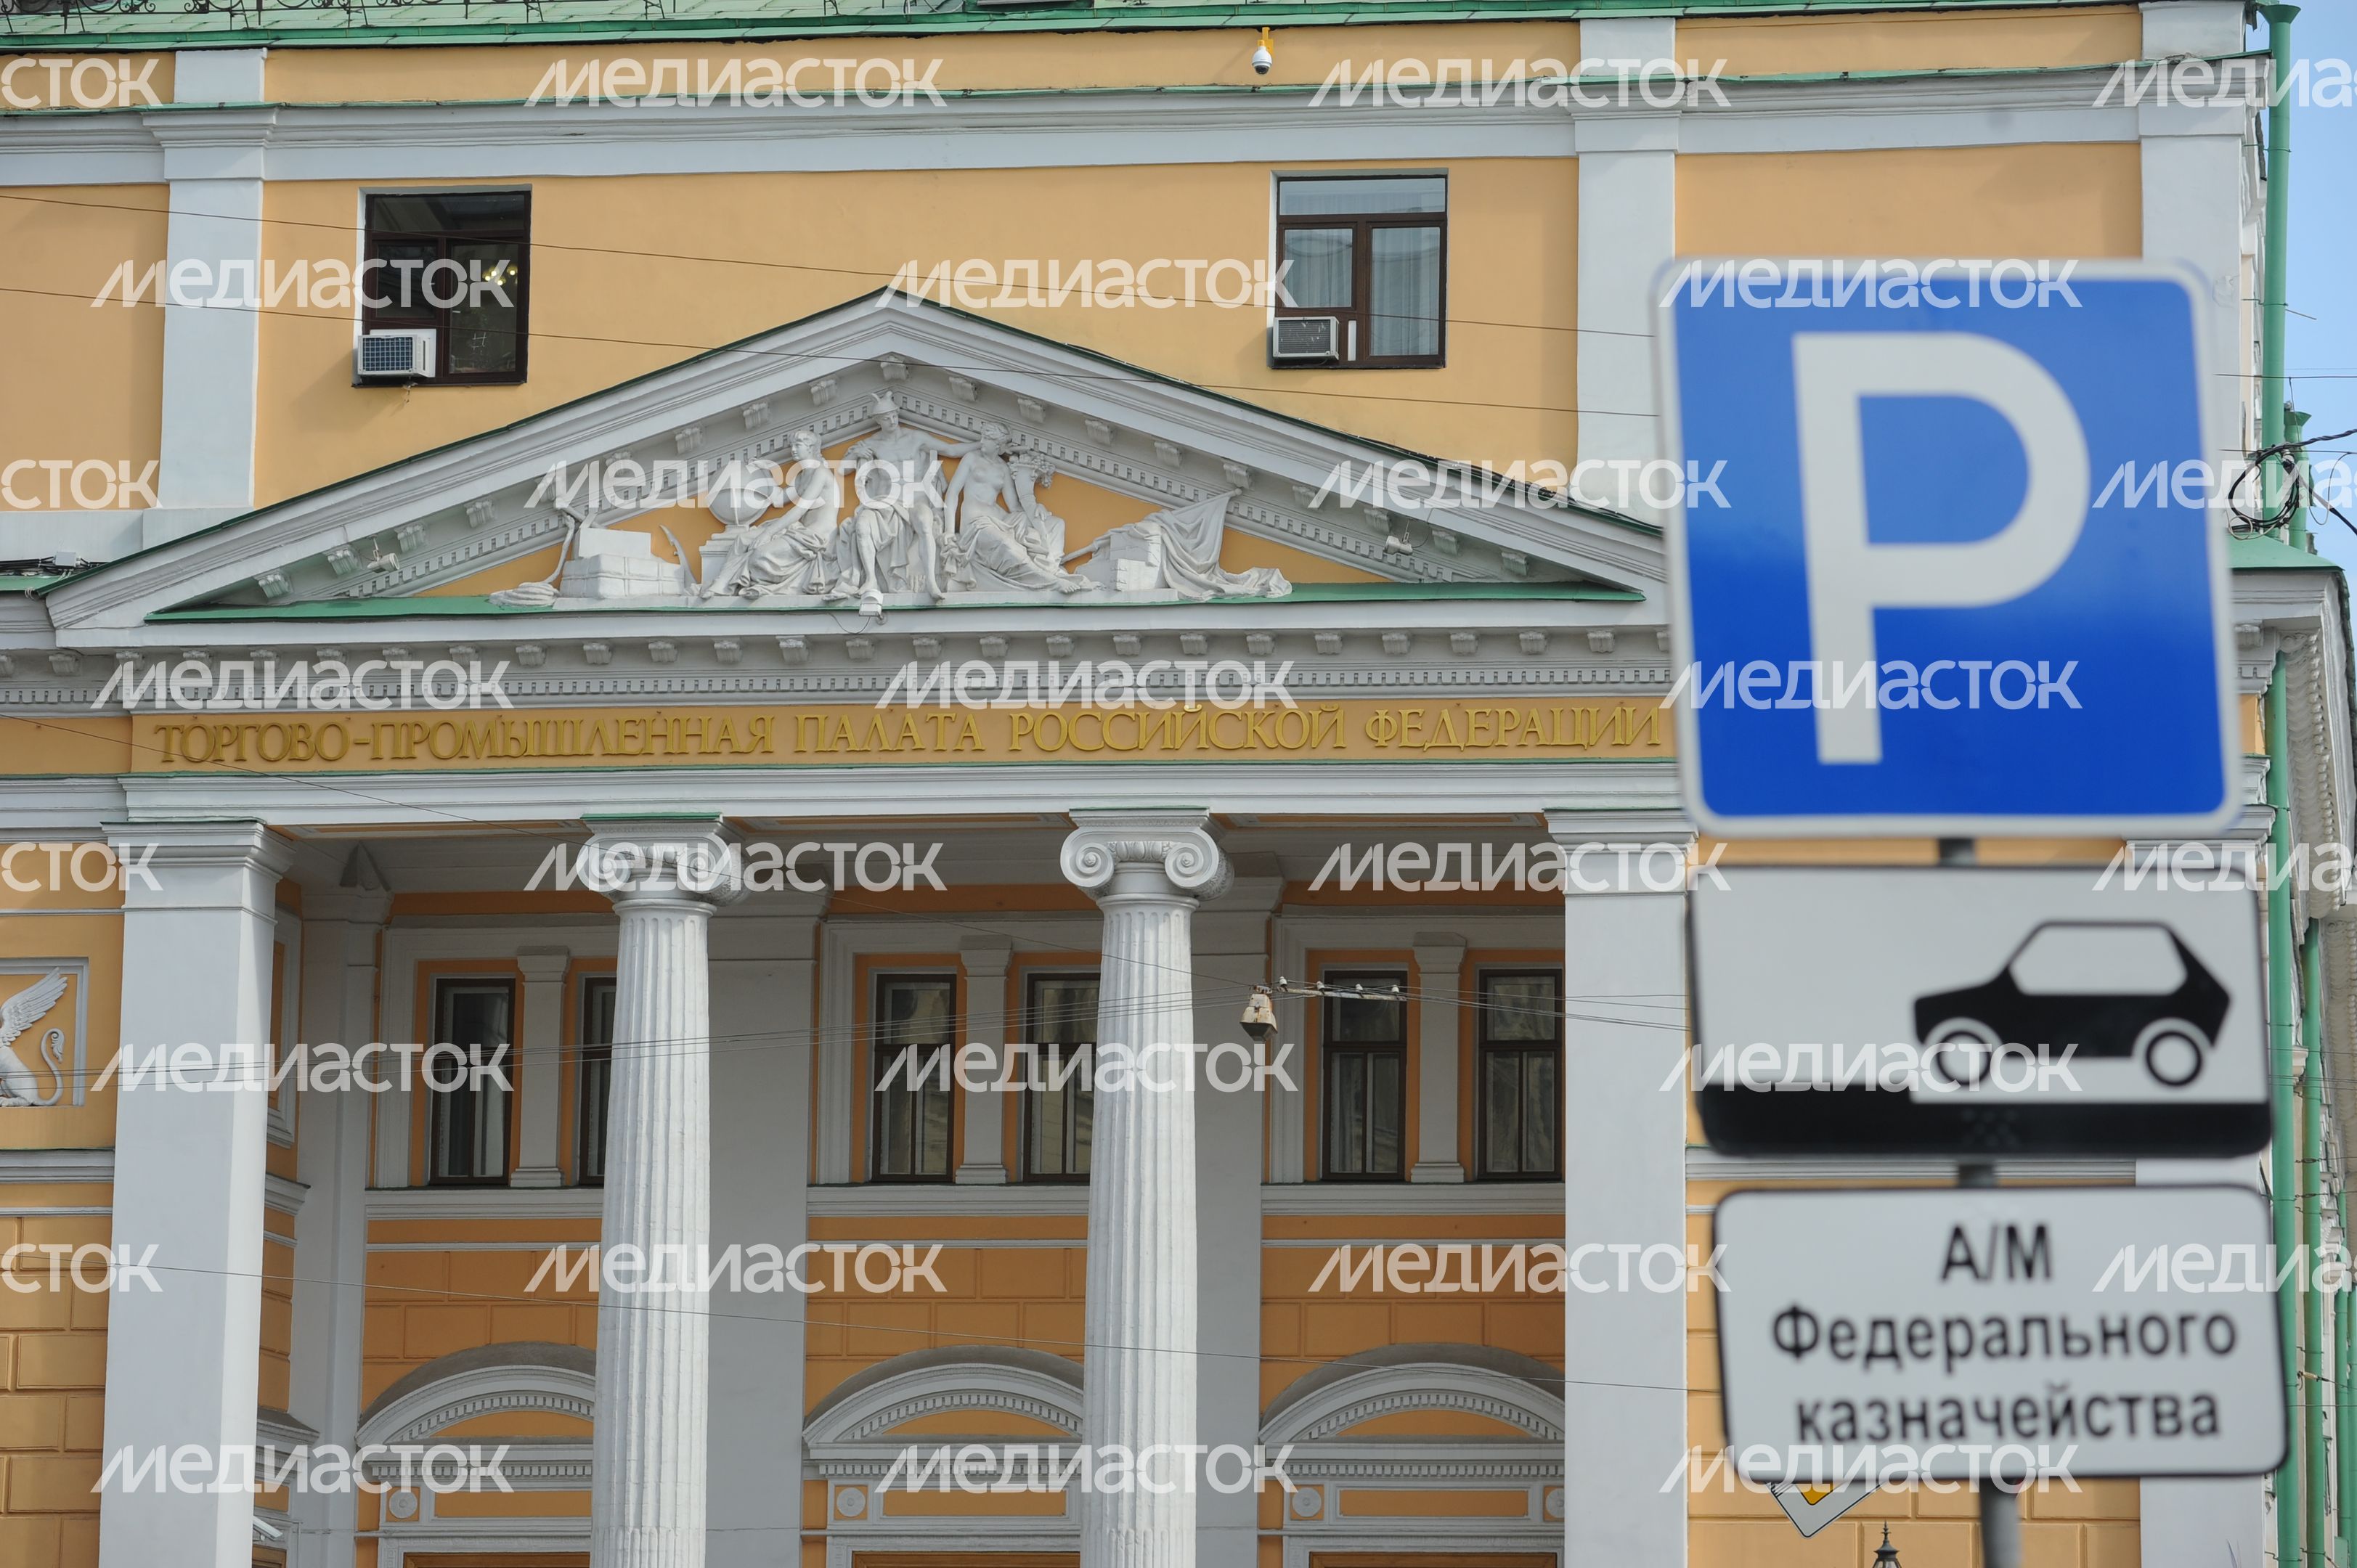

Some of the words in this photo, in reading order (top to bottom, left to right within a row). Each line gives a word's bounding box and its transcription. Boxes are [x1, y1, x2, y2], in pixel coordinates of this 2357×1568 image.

[155, 716, 774, 762] ТОРГОВО-ПРОМЫШЛЕННАЯ
[794, 713, 985, 753] ПАЛАТА
[1009, 704, 1346, 751] РОССИЙСКОЙ
[1365, 707, 1661, 751] ФЕДЕРАЦИИ
[1941, 1222, 2051, 1282] А/М
[1771, 1305, 2238, 1371] Федерального
[1797, 1384, 2220, 1443] казначейства
